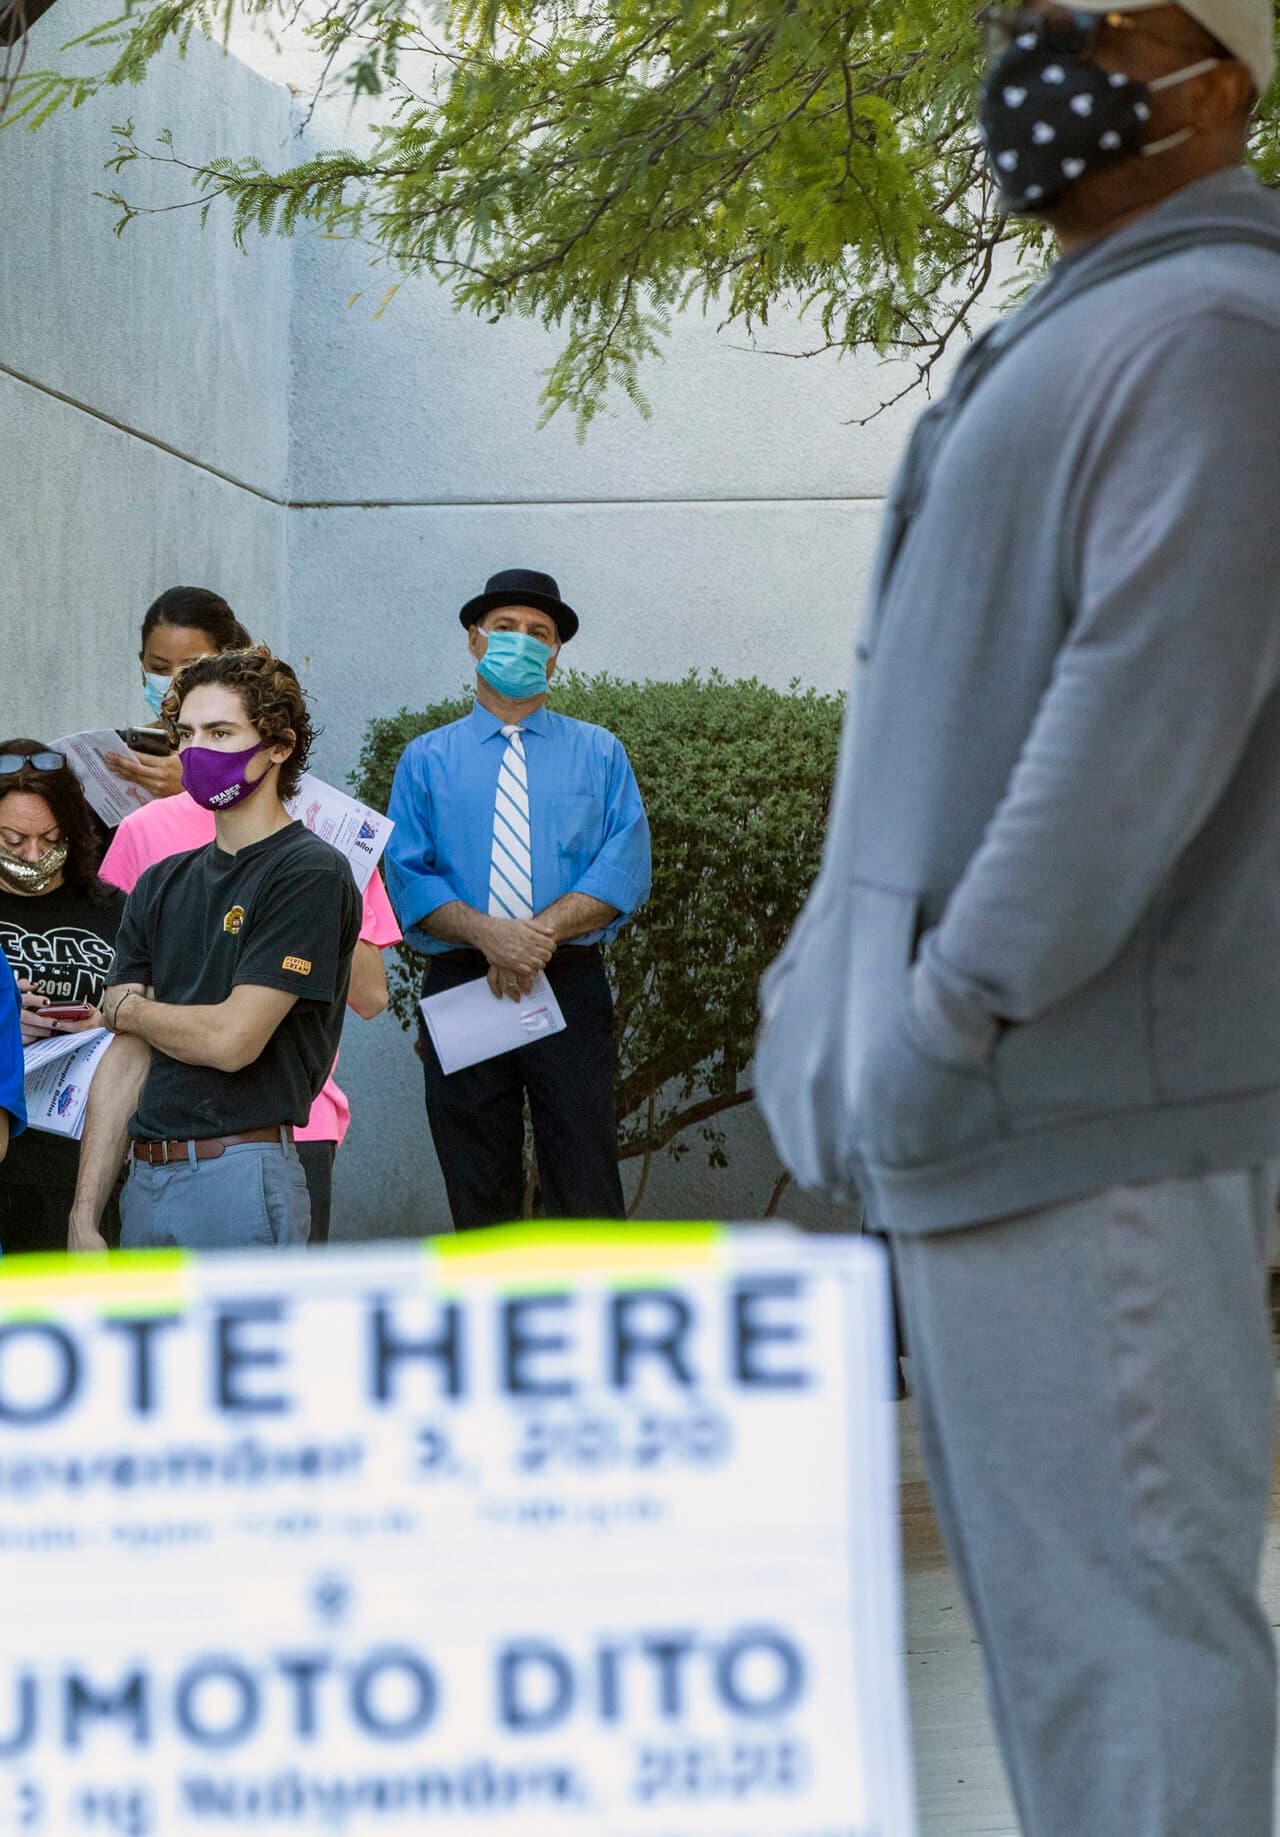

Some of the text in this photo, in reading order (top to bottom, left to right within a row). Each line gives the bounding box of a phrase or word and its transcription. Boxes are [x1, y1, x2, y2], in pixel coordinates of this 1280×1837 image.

[209, 784, 241, 803] TRADER
[354, 839, 374, 855] allot
[37, 979, 72, 996] 2019
[46, 1089, 61, 1117] Ballot
[366, 1275, 812, 1406] HERE
[522, 1412, 730, 1472] 2020
[494, 1626, 808, 1734] DITO
